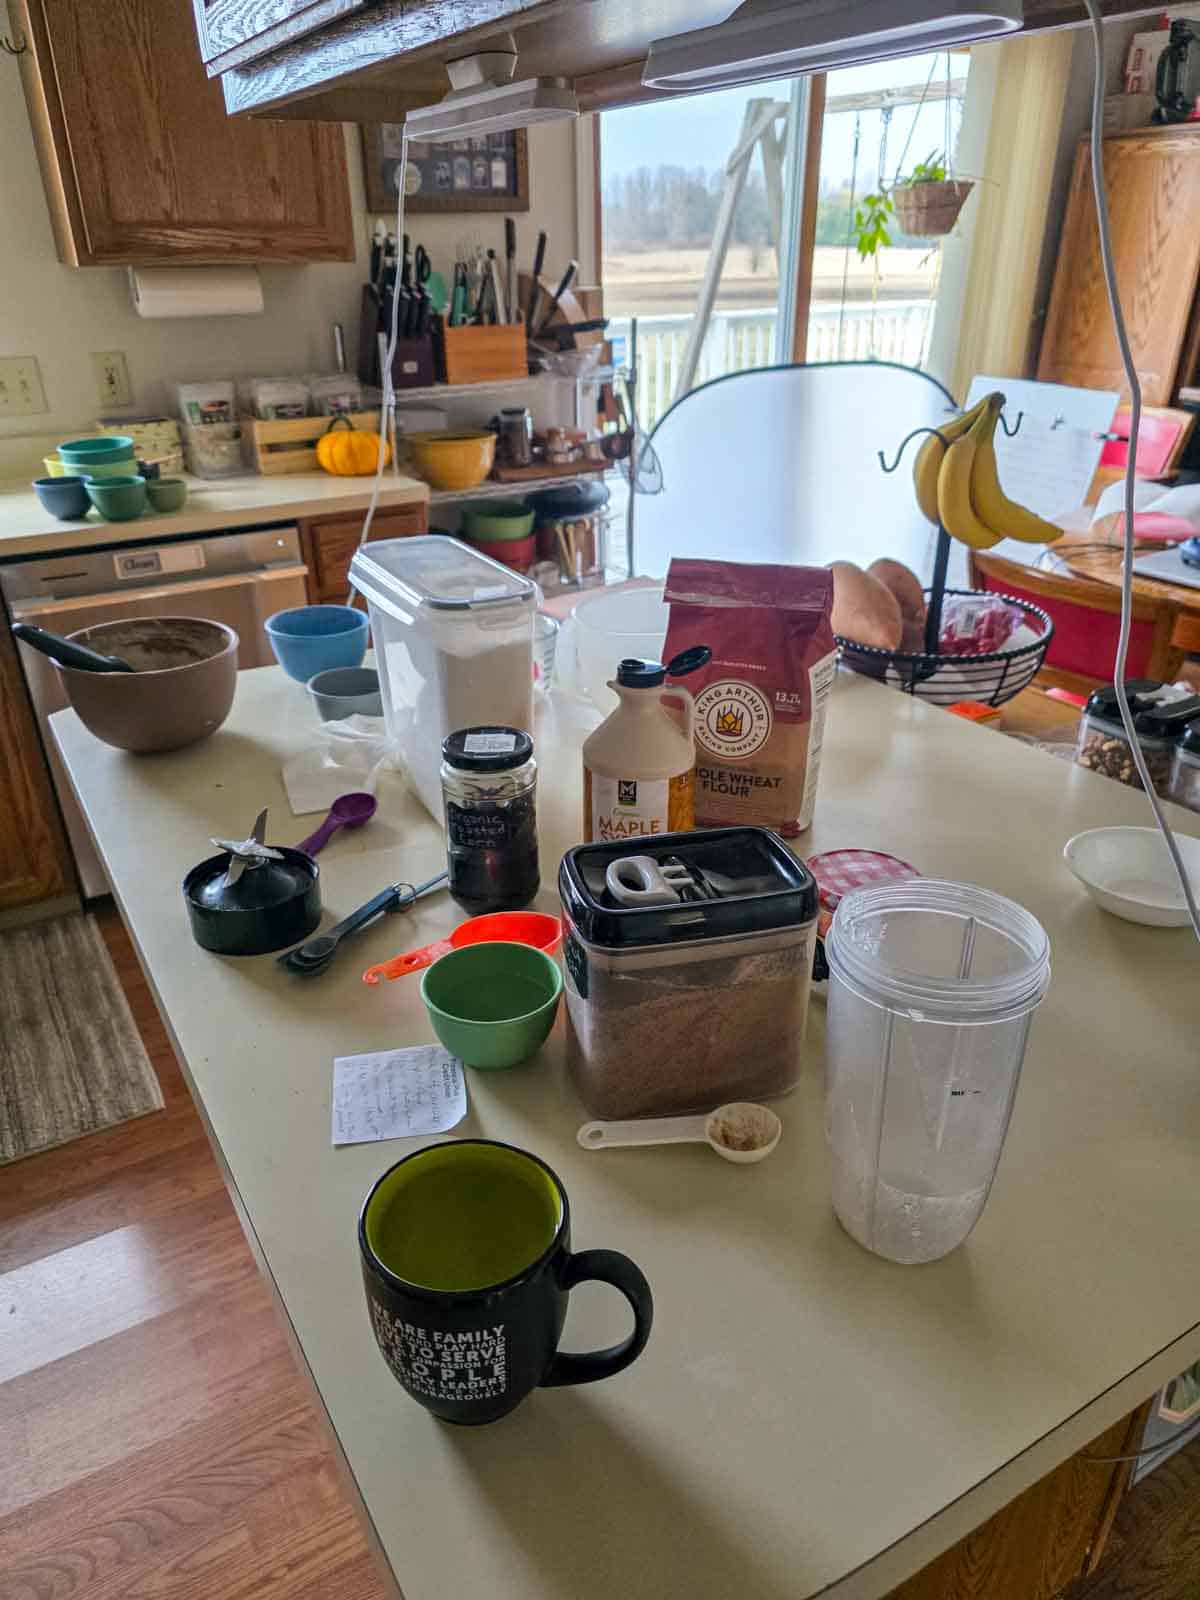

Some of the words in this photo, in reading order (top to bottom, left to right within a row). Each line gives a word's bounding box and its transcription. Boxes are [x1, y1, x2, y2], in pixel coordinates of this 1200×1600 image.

[697, 690, 722, 715] KING
[726, 687, 765, 721] ARTHUR
[698, 726, 723, 751] BAKING
[725, 732, 761, 753] COMPANY
[696, 767, 728, 783] OLE
[729, 773, 783, 789] WHEAT
[703, 780, 750, 798] FLOUR
[599, 816, 661, 834] MAPLE
[393, 1318, 427, 1341] ARE
[433, 1324, 505, 1343] FAMILY
[440, 1343, 506, 1363] SERVE
